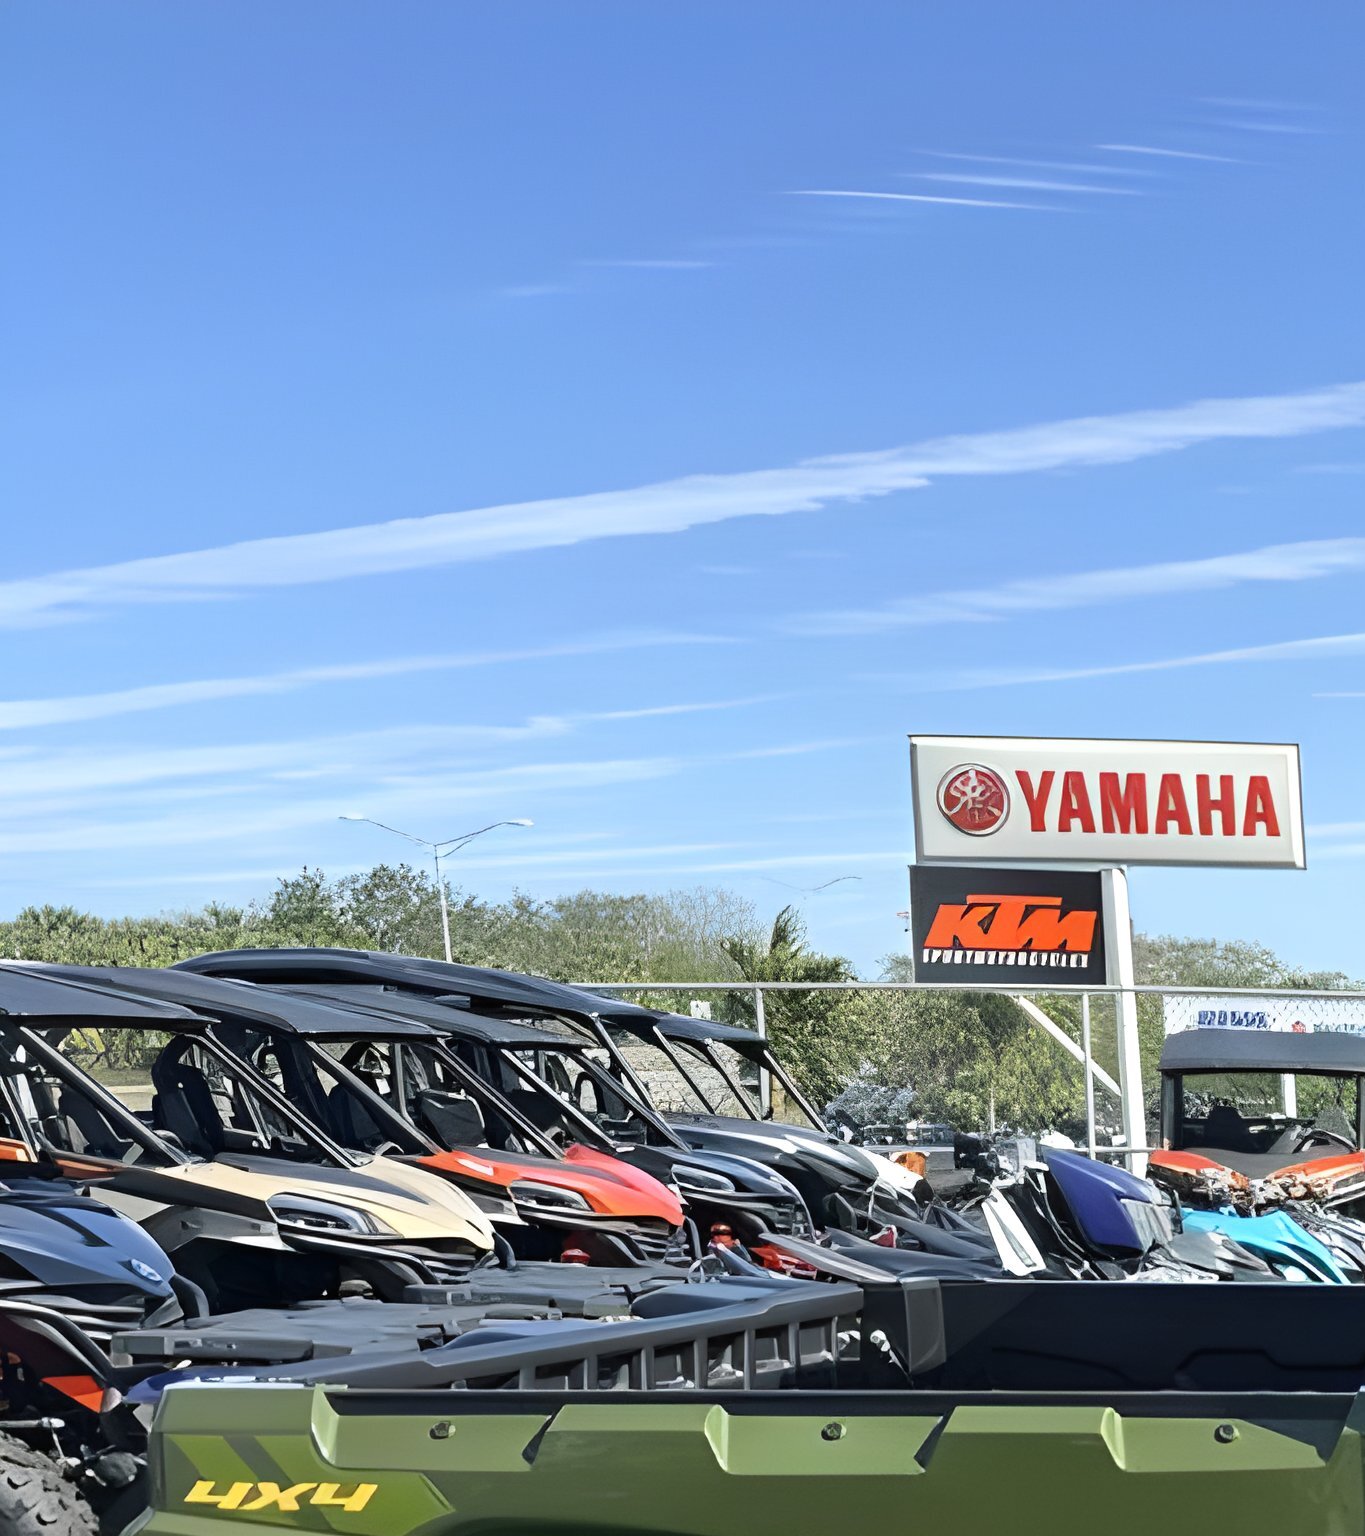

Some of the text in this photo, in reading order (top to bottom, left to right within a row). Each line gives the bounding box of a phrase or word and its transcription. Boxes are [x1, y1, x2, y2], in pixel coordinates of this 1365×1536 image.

[1014, 770, 1281, 837] YAMAHA
[923, 894, 1098, 953] KTM
[184, 1480, 379, 1512] 4X4
